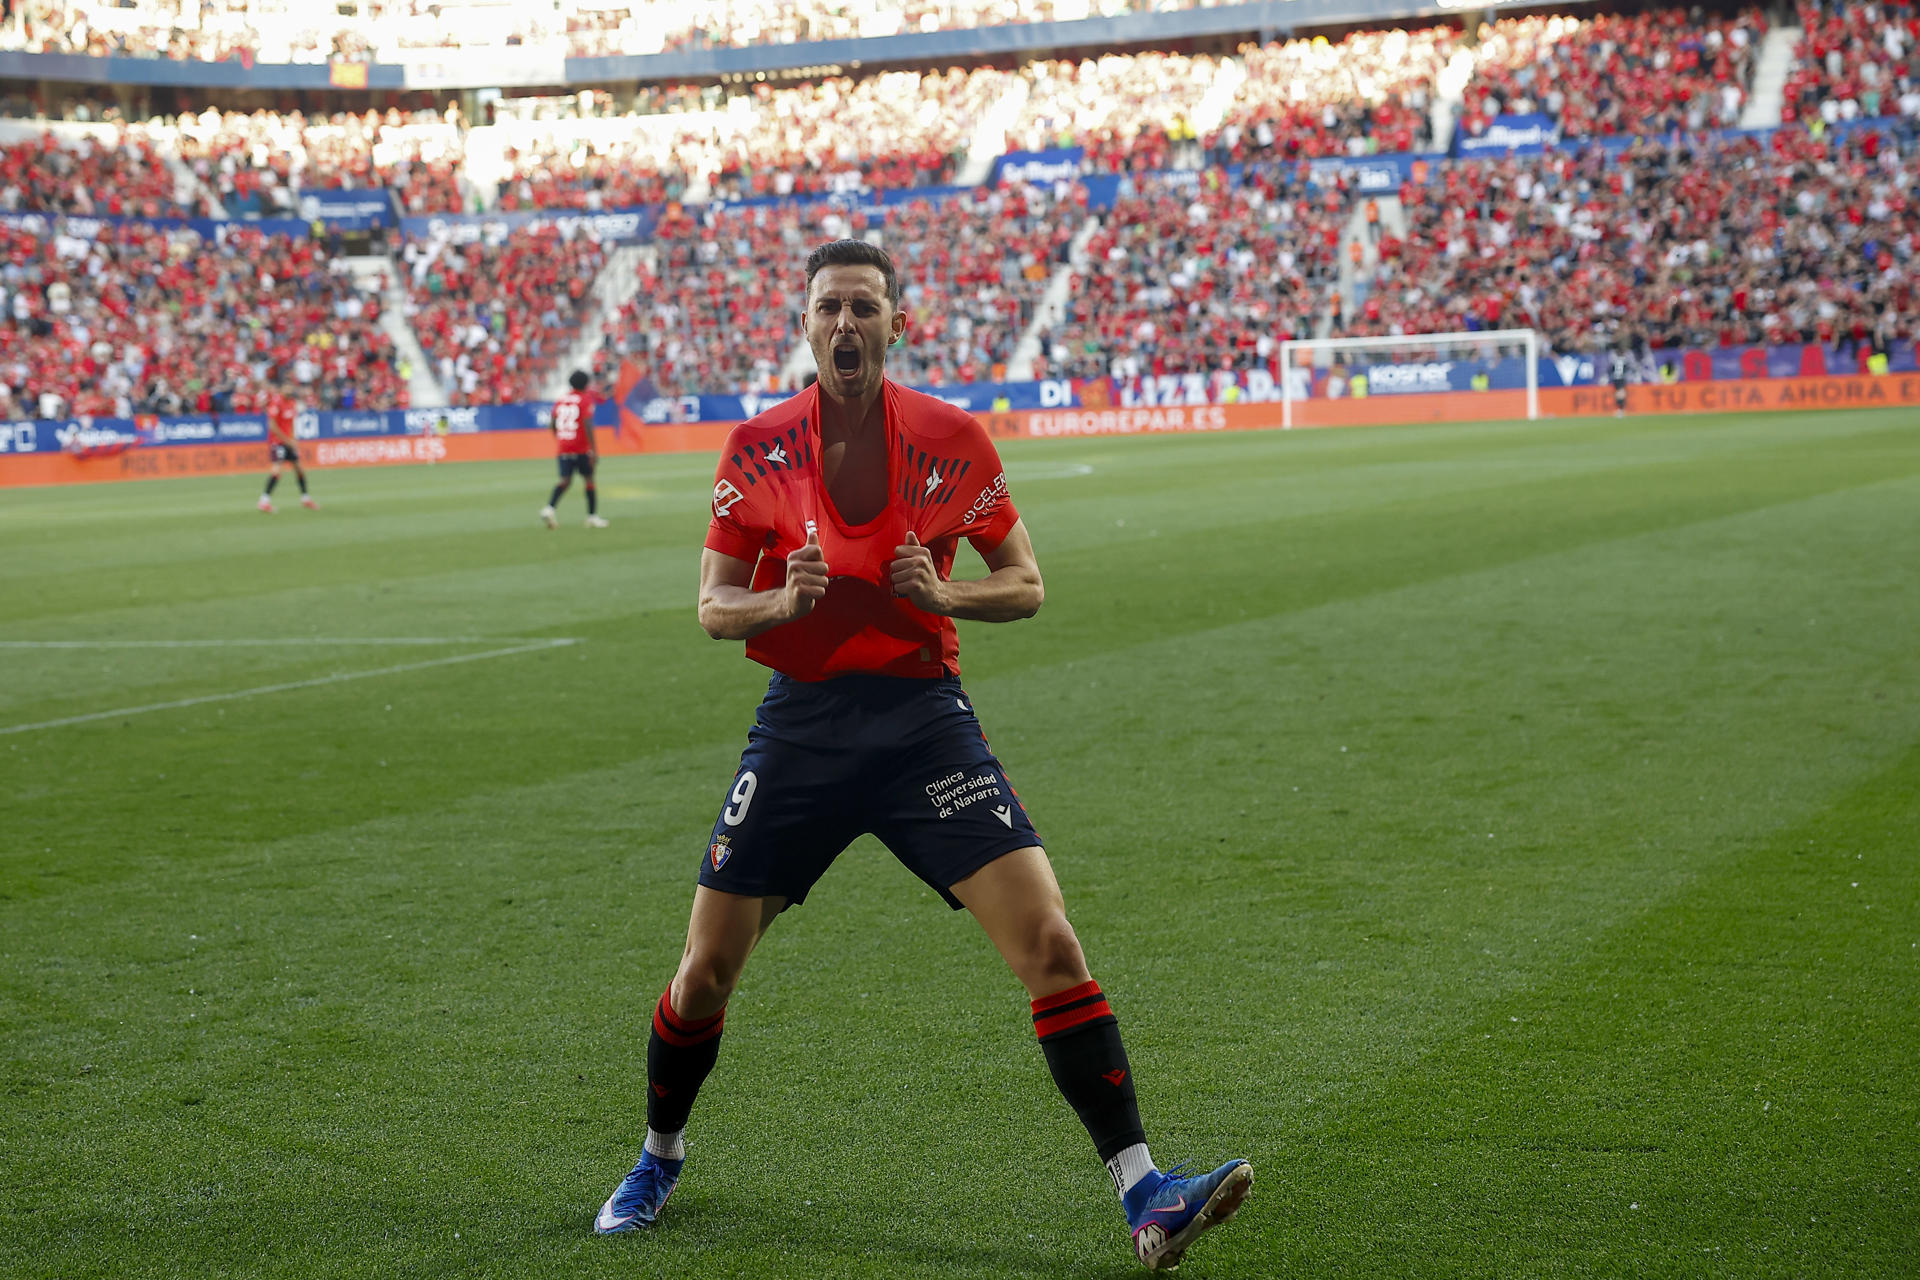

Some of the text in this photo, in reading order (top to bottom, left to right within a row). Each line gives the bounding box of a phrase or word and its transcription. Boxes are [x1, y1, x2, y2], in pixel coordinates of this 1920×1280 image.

[1701, 379, 1764, 406] CITA
[1779, 374, 1886, 403] AHORA
[1029, 406, 1227, 437] EUROREPAR.ES
[723, 771, 757, 826] 9
[925, 771, 964, 796] Clínica
[931, 773, 997, 807] Universidad
[939, 787, 1000, 819] de Navarra
